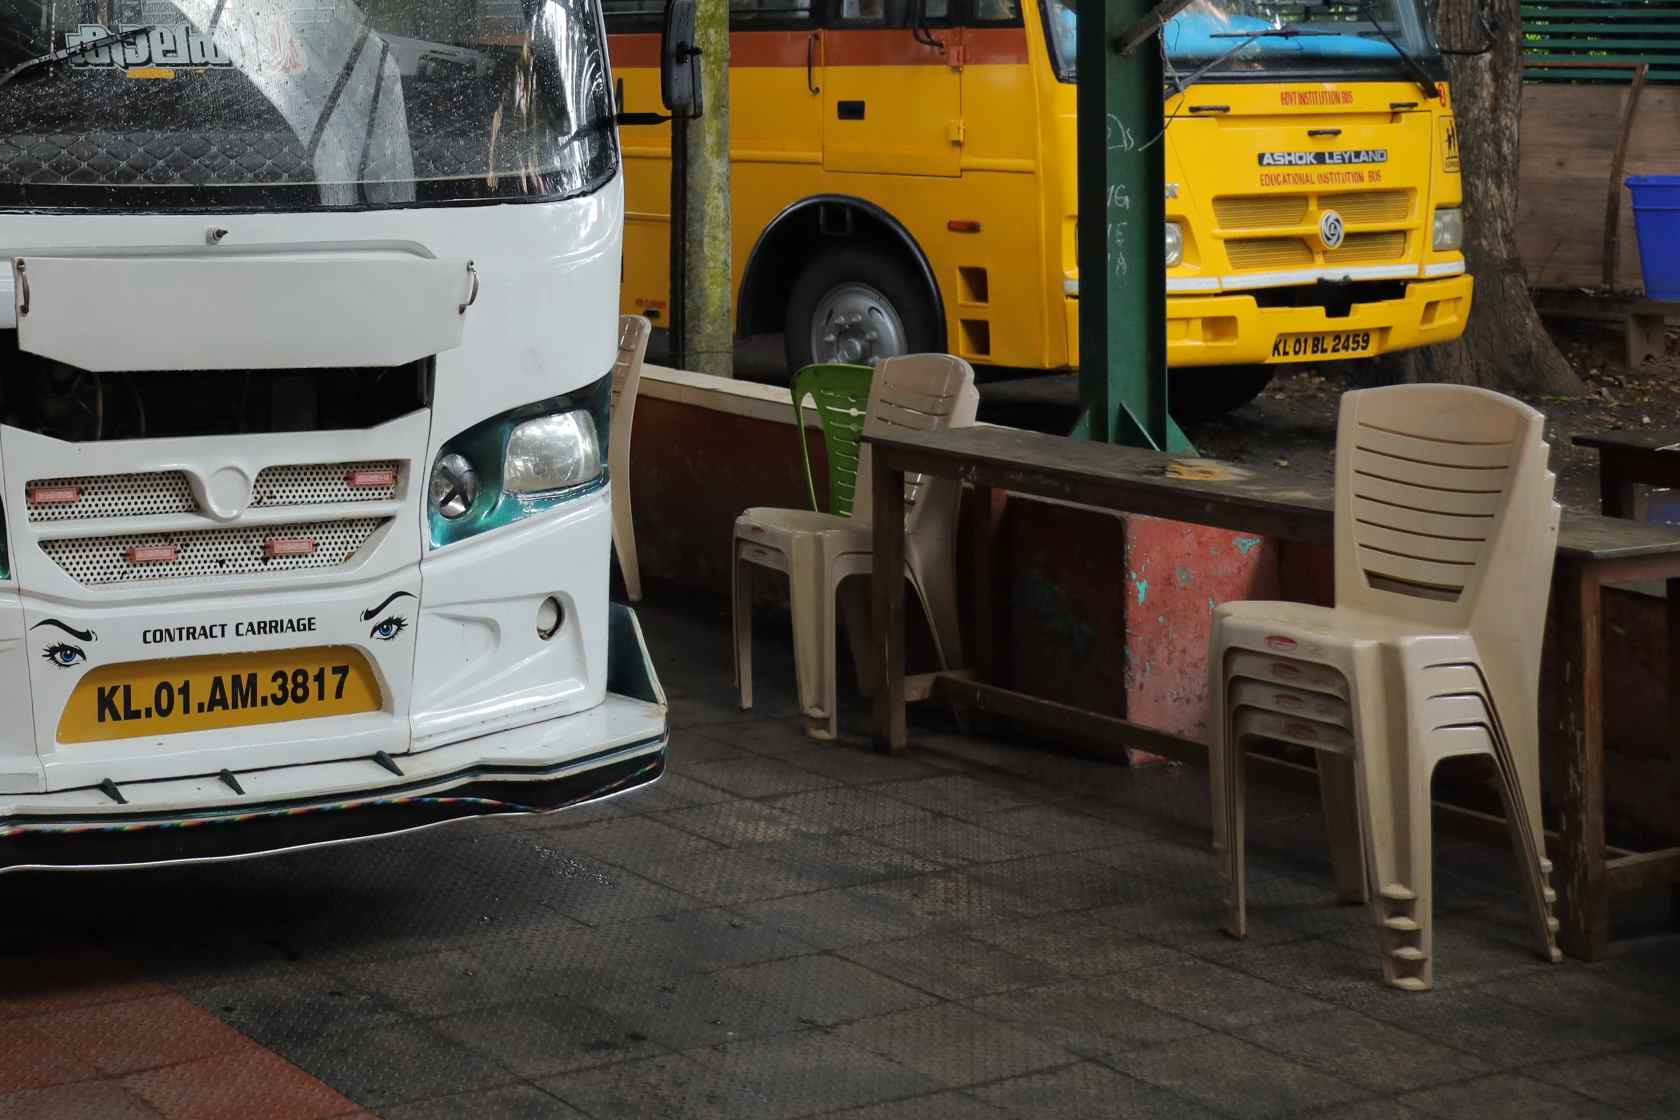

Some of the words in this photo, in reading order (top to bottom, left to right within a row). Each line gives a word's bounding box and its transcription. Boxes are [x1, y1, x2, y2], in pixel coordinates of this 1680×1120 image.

[1262, 152, 1318, 165] ASHOK
[1325, 149, 1387, 164] LEYLAND
[1260, 172, 1315, 186] EDUCATIONAL
[1317, 171, 1364, 185] INSTITUTION
[1272, 336, 1289, 357] KL
[1293, 337, 1308, 355] 01
[1311, 336, 1328, 354] BL
[1331, 332, 1370, 352] 2459
[142, 623, 227, 645] CONTRACT
[236, 617, 317, 638] CARRIAGE
[97, 665, 351, 723] KL.01.AM.3817
